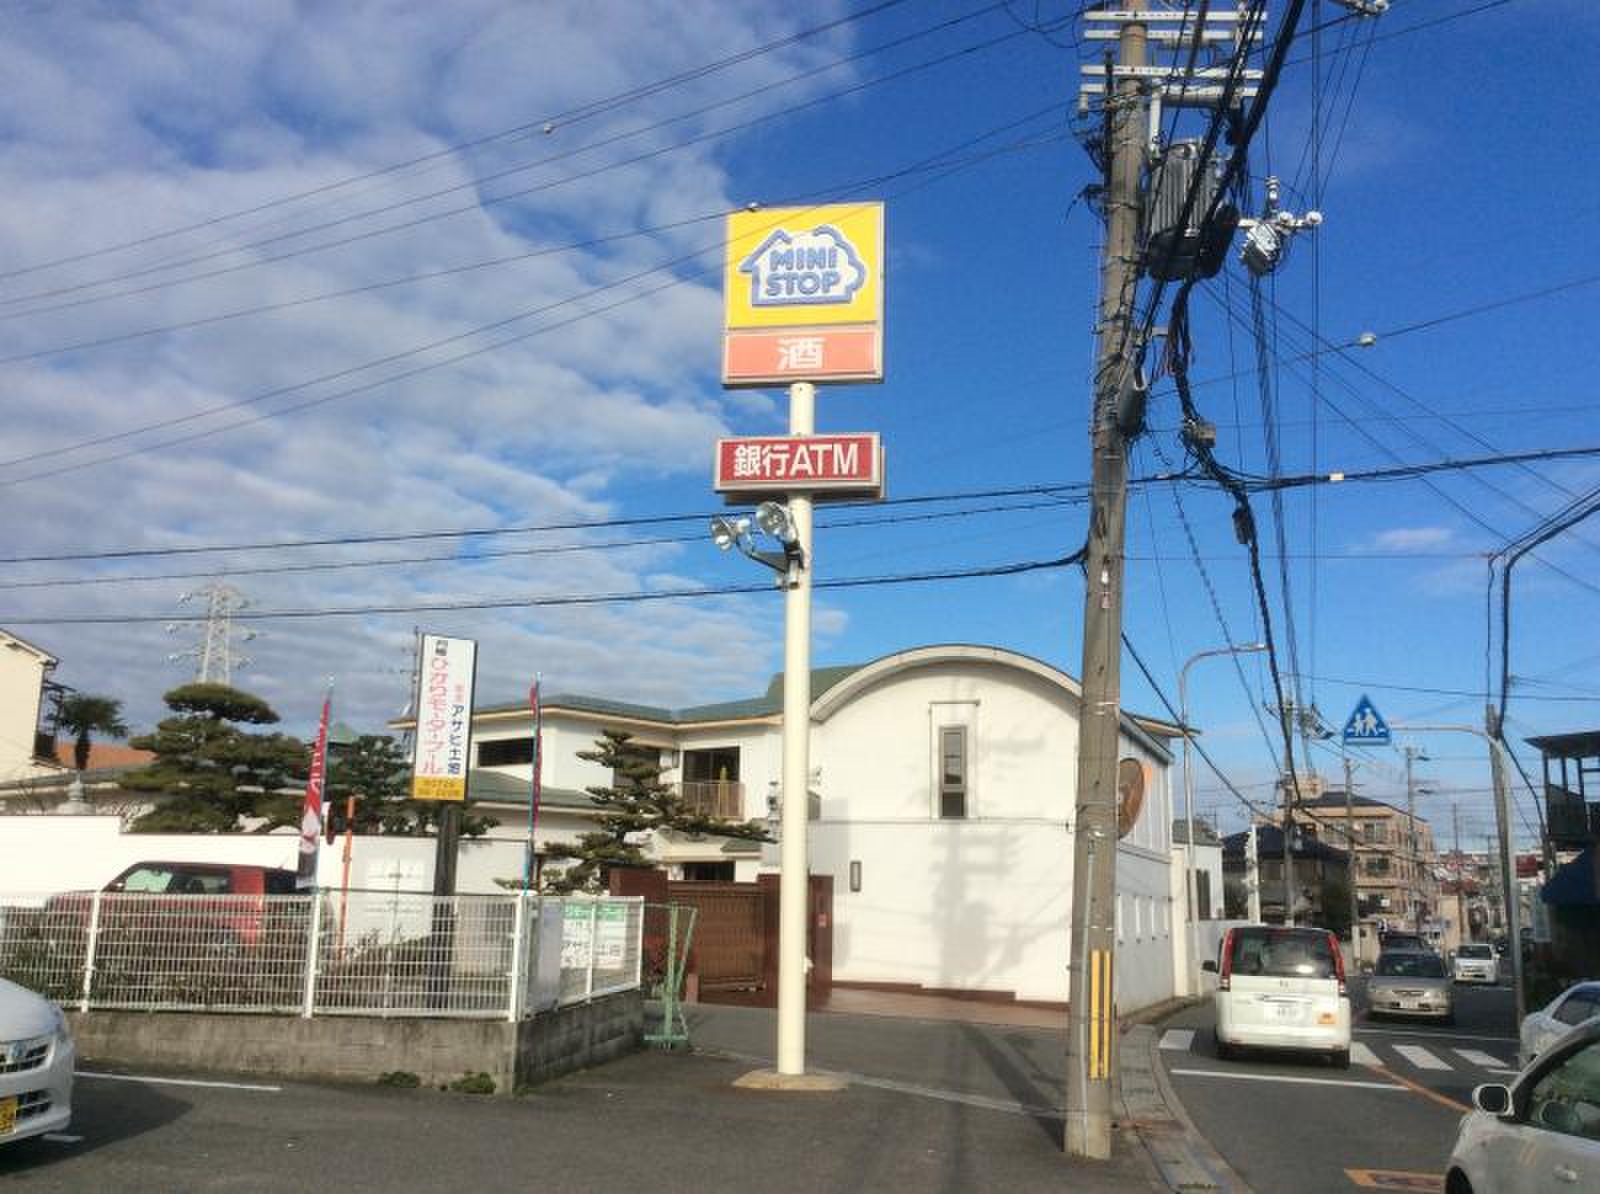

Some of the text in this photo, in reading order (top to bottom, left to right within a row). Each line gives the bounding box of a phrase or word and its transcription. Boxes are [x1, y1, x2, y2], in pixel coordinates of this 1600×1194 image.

[770, 247, 838, 272] MINI
[765, 271, 842, 297] STOP
[776, 337, 825, 371] 酒
[733, 443, 859, 478] 銀行ATM
